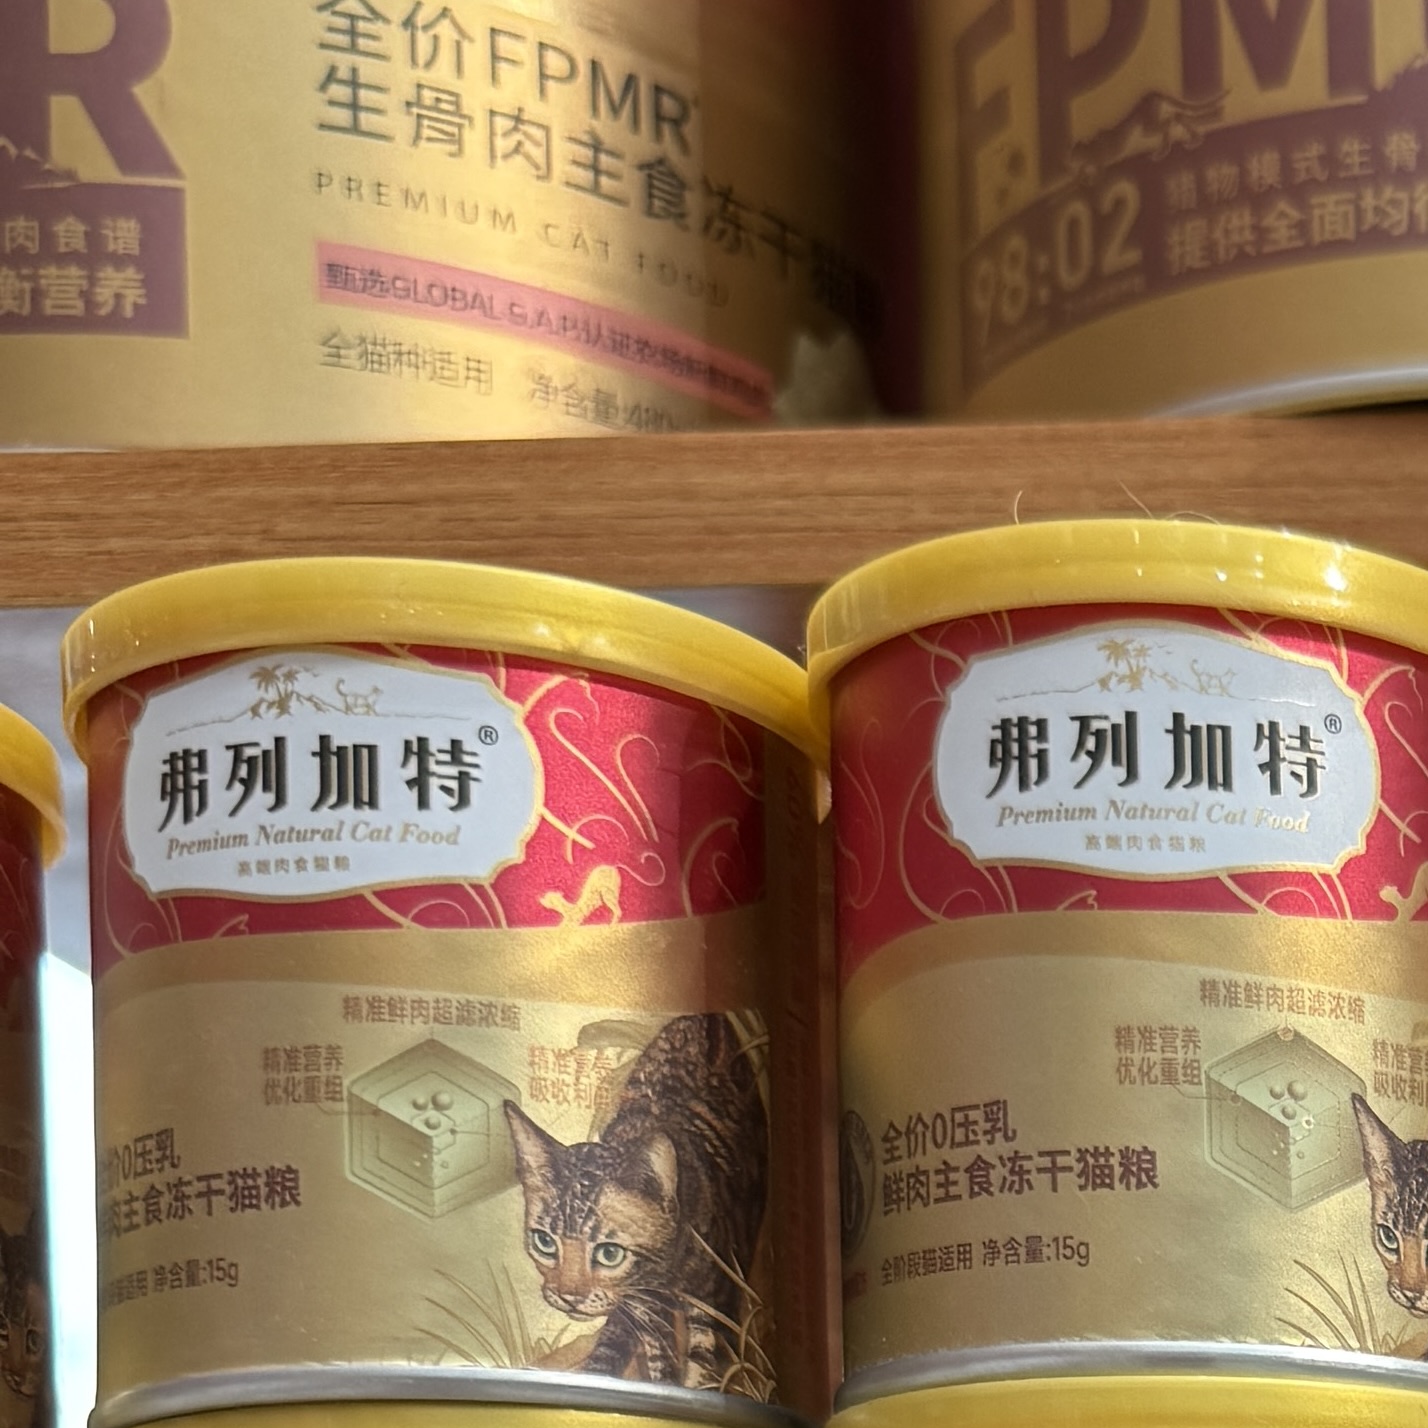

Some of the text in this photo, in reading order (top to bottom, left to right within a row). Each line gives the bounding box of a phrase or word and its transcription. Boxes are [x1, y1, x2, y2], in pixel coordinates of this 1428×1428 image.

[985, 711, 1329, 799] 弗列加特
[158, 733, 482, 833] 弗列加特
[996, 798, 1310, 833] Premium Natural Cat Food
[1199, 979, 1365, 1026] 精准鲜肉超滤浓缩
[1114, 1025, 1201, 1056] 精准营养
[1115, 1057, 1203, 1088] 优化重组
[880, 1101, 1017, 1165] 全价0压乳
[881, 1146, 1159, 1214] 鲜肉主食冻干猫粮
[982, 1236, 1090, 1268] 净含量:15g
